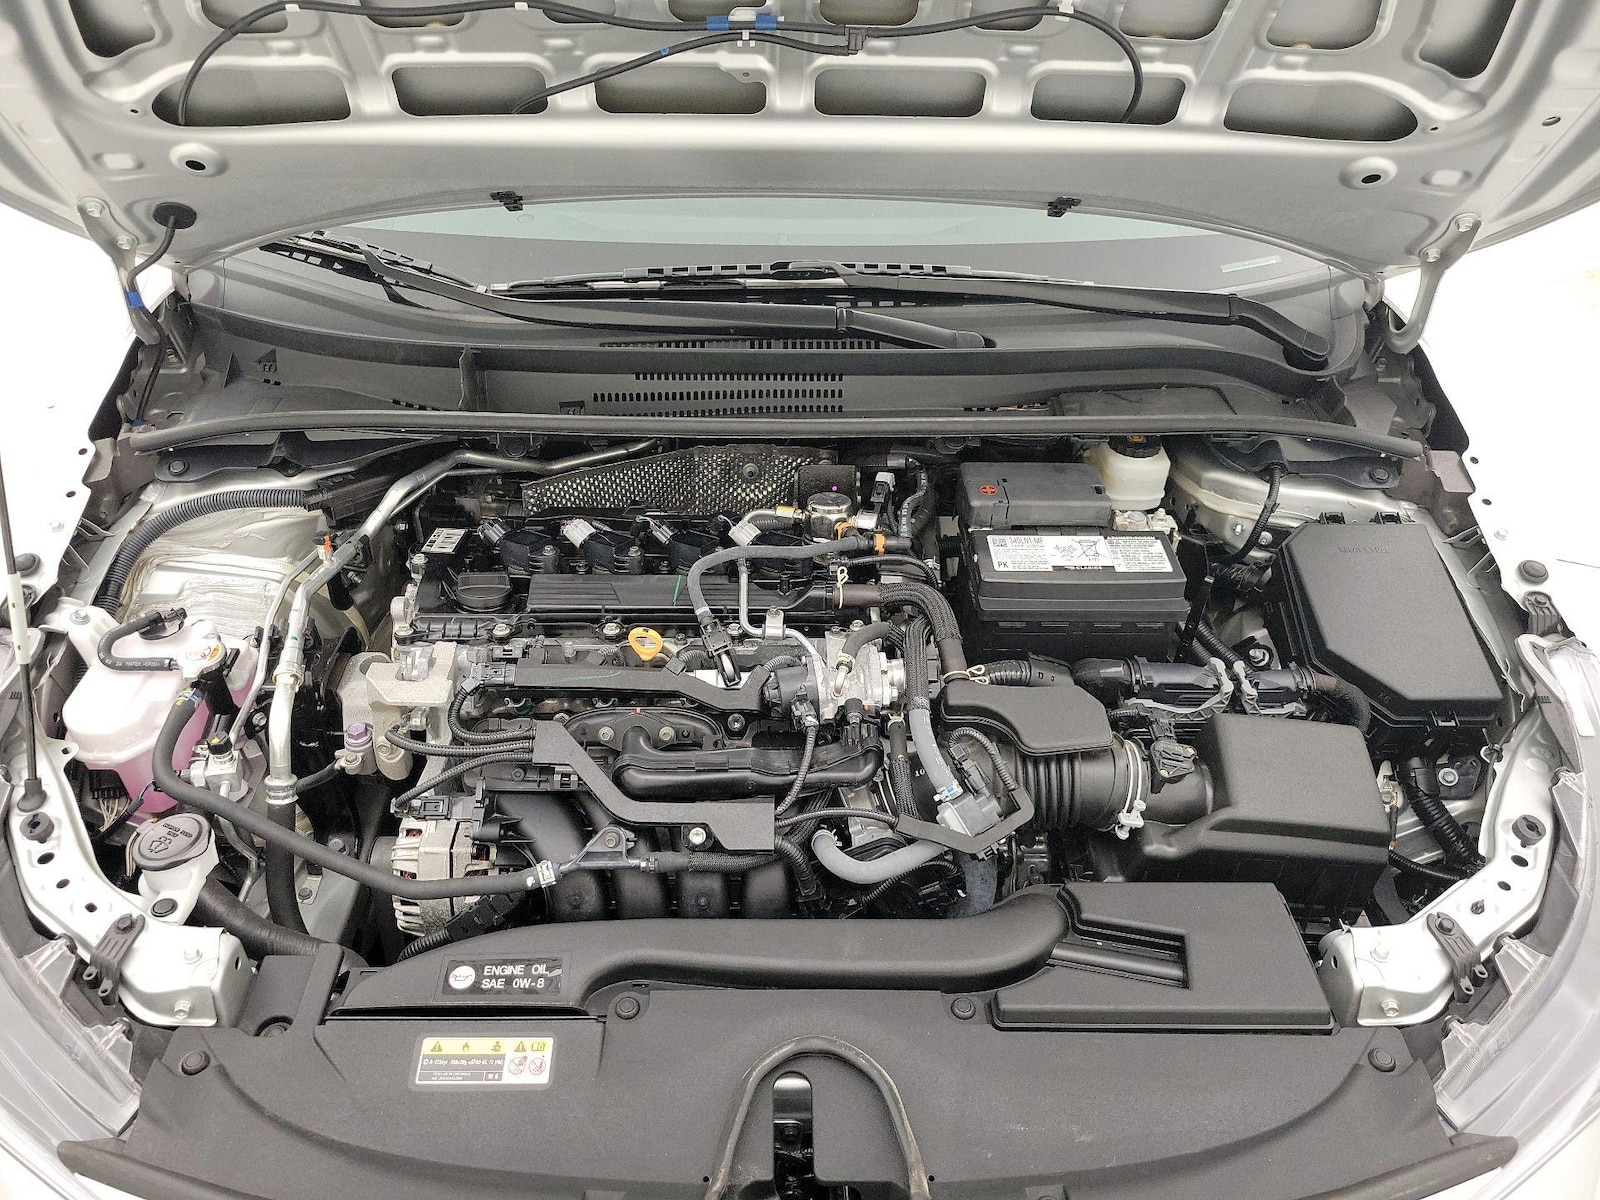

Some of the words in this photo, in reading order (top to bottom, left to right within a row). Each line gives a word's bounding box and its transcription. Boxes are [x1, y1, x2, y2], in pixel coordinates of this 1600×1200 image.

[483, 964, 525, 976] ENGINE
[531, 964, 550, 975] OIL
[481, 978, 505, 989] SAE
[512, 977, 545, 989] 0W-8
